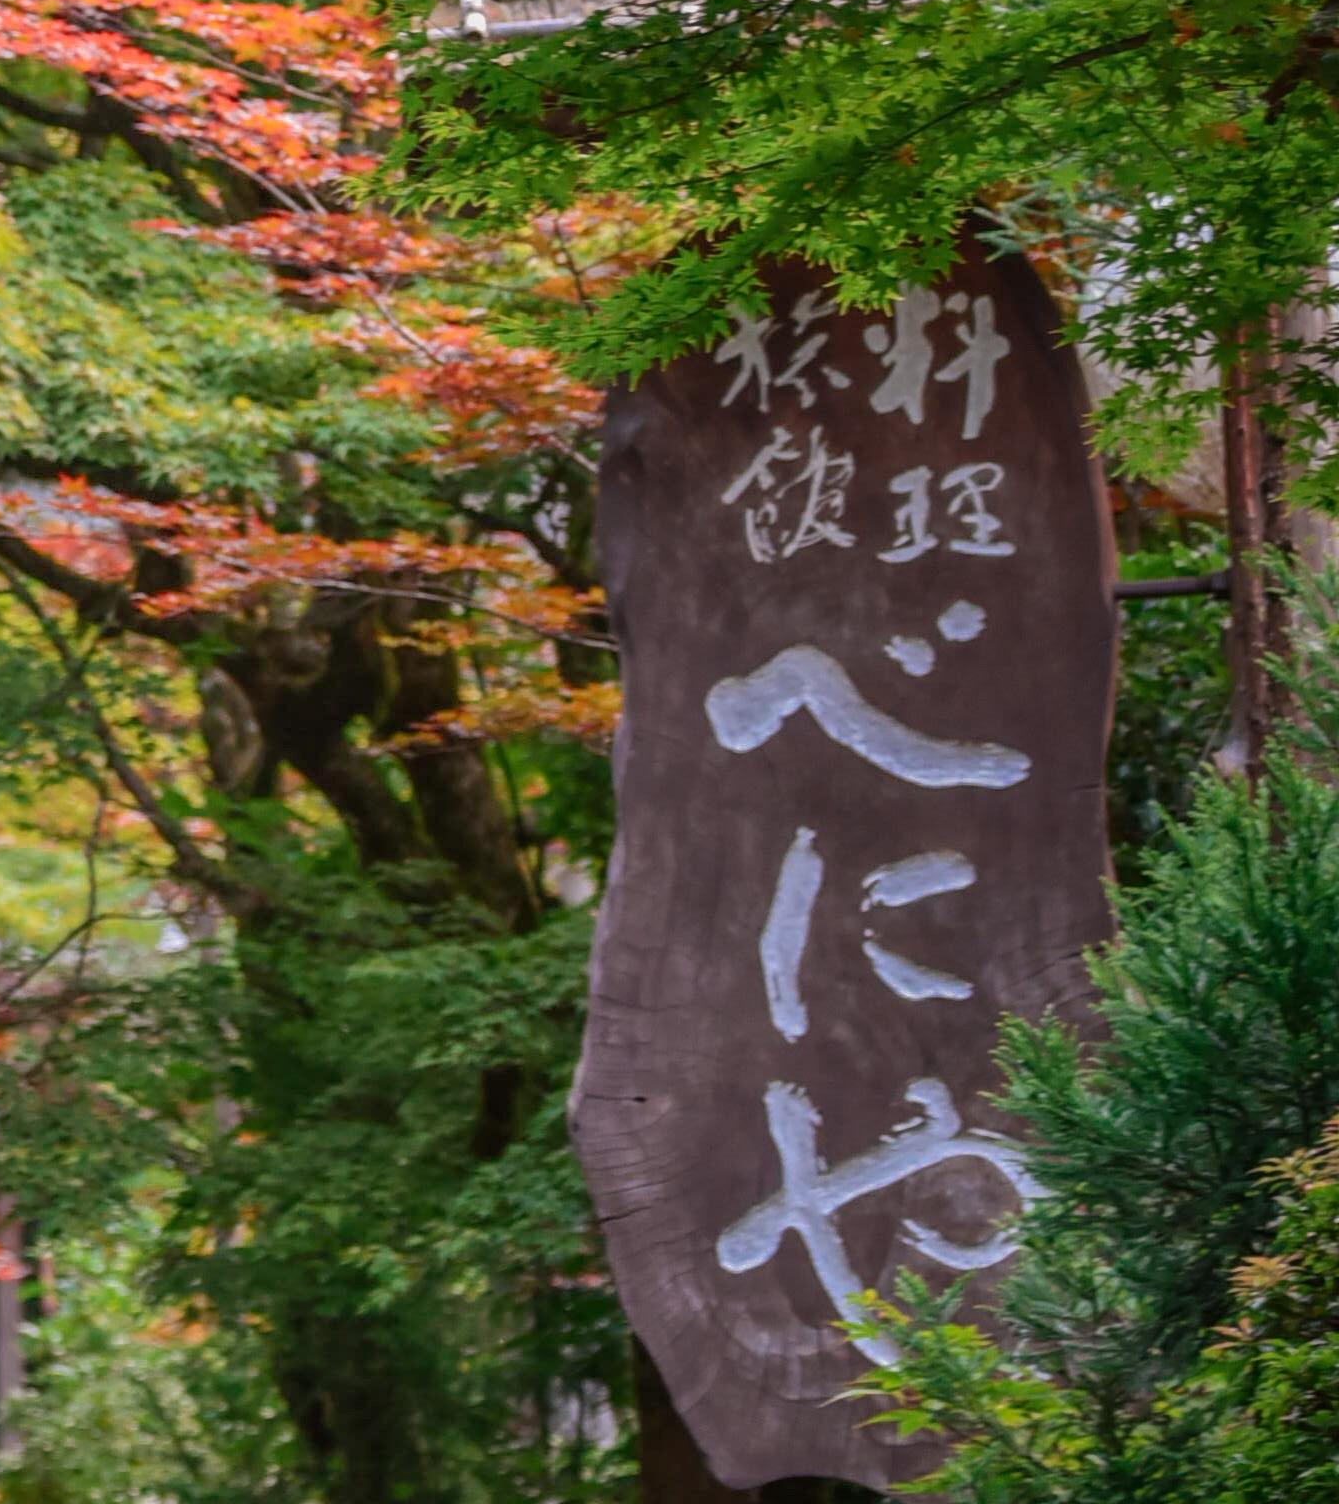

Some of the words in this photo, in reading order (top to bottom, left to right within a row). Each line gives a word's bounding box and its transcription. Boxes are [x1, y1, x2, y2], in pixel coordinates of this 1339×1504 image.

[863, 279, 1016, 564] 料理
[705, 599, 1060, 1370] べにや
